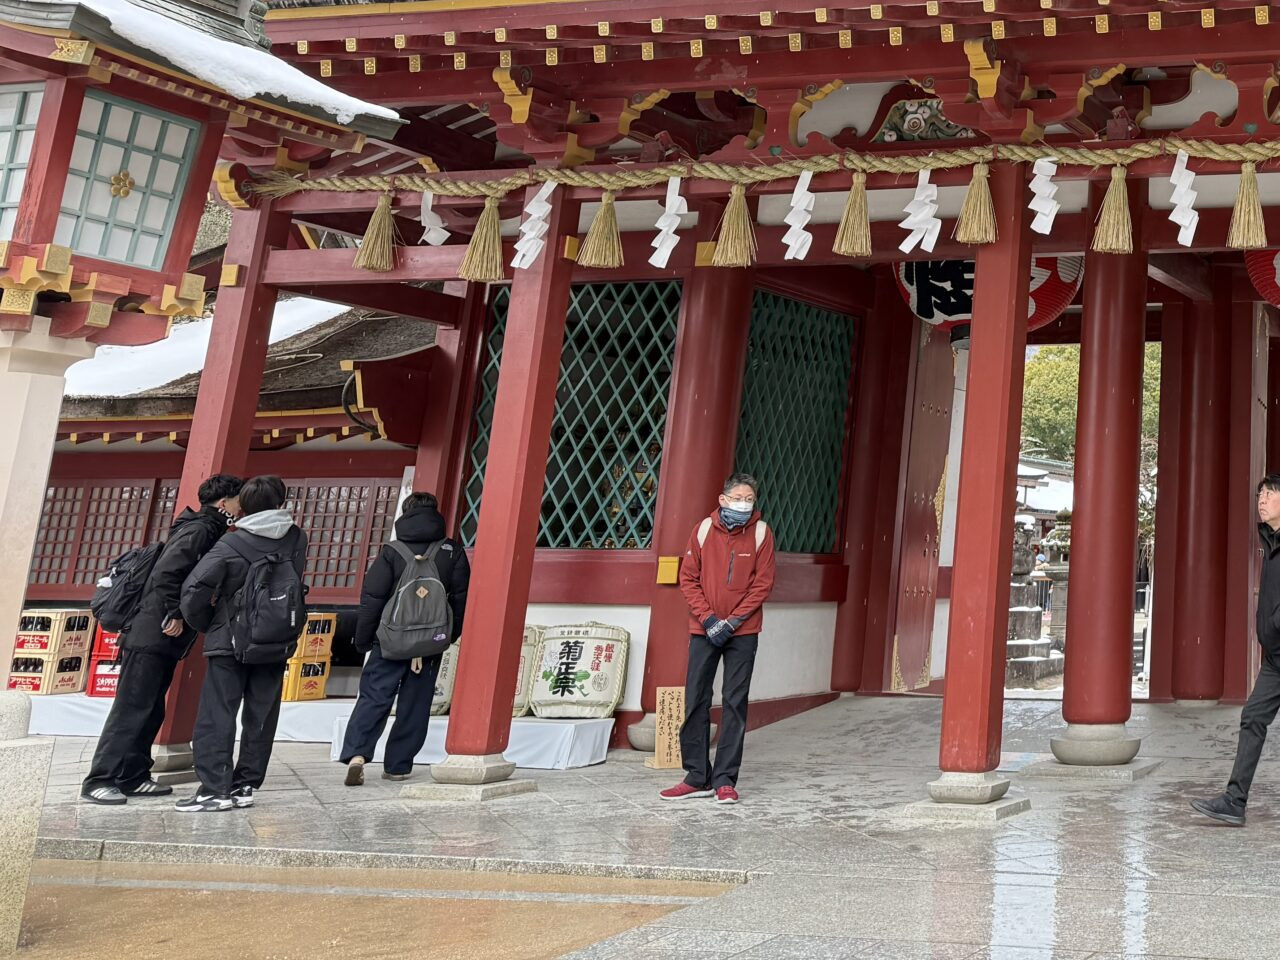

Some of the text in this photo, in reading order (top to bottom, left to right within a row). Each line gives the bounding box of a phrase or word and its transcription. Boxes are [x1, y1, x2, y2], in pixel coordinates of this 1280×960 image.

[18, 635, 49, 643] アサヒビール
[551, 640, 585, 697] 菊正宗
[10, 677, 41, 685] アサヒビール
